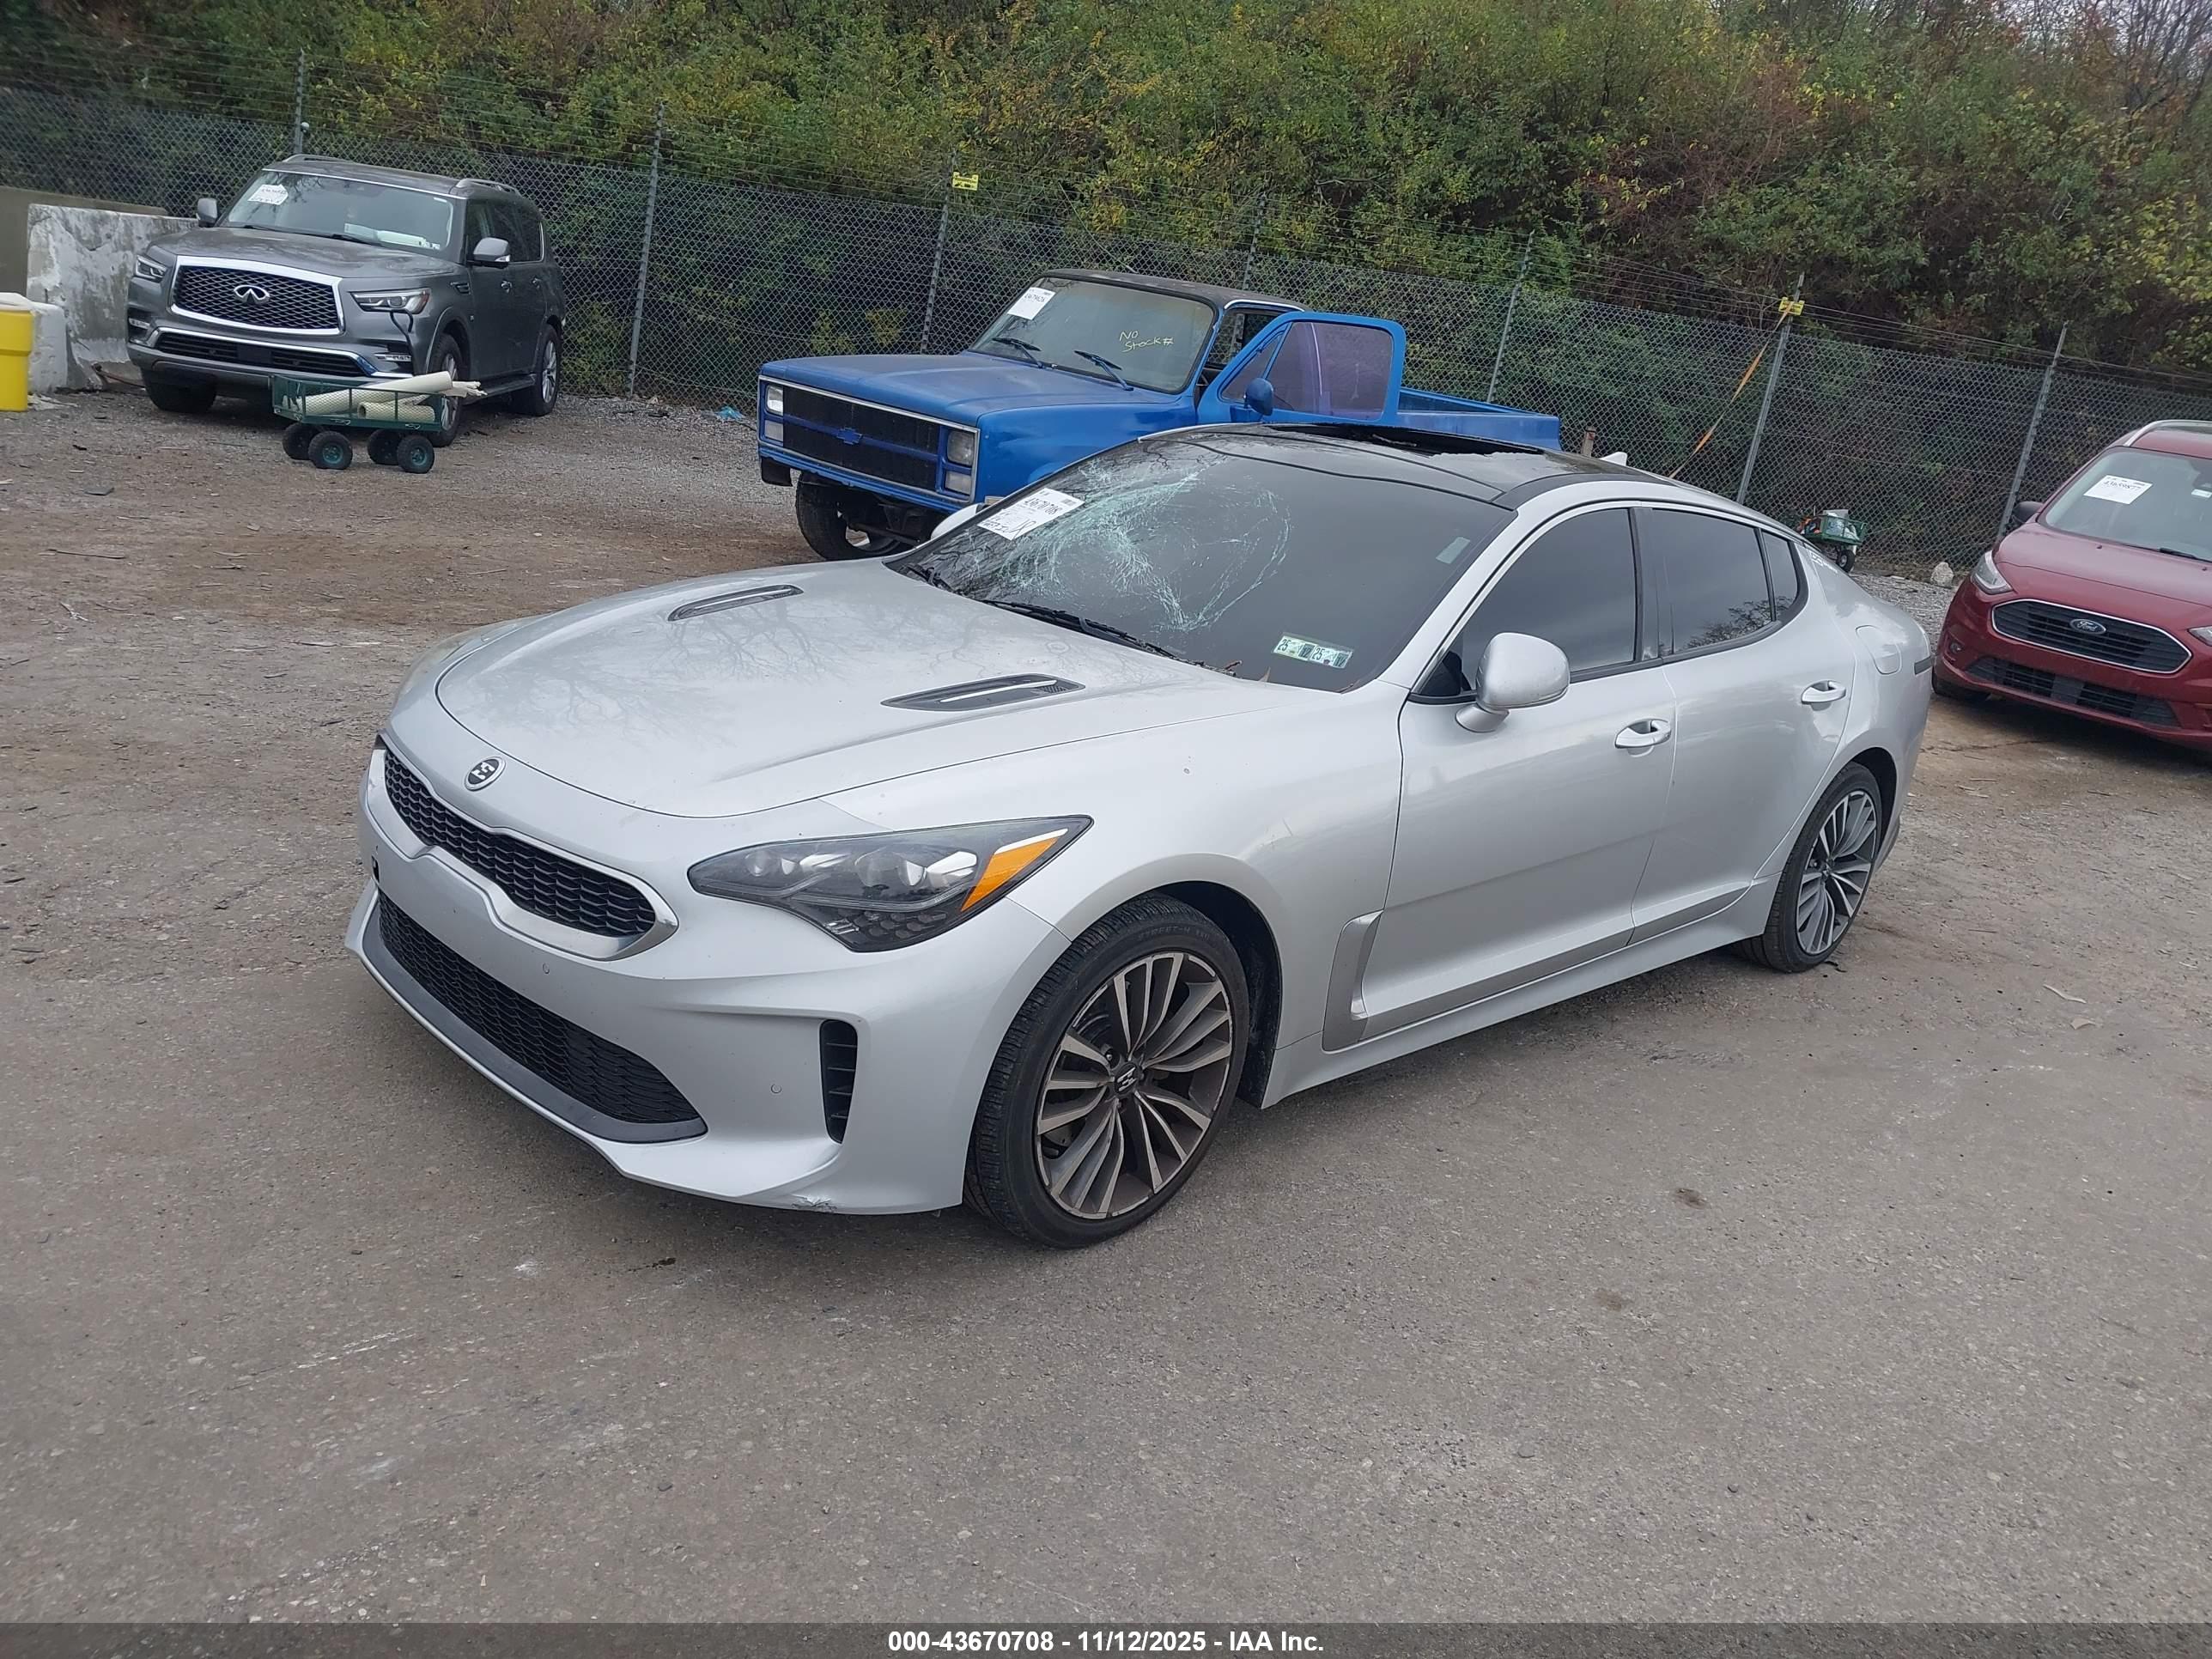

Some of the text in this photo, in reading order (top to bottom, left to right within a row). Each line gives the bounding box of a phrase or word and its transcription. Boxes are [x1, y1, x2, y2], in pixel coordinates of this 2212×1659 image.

[1119, 330, 1139, 342] NO
[2076, 620, 2099, 631] Ford
[1277, 638, 1292, 652] 25
[1312, 647, 1326, 660] 25
